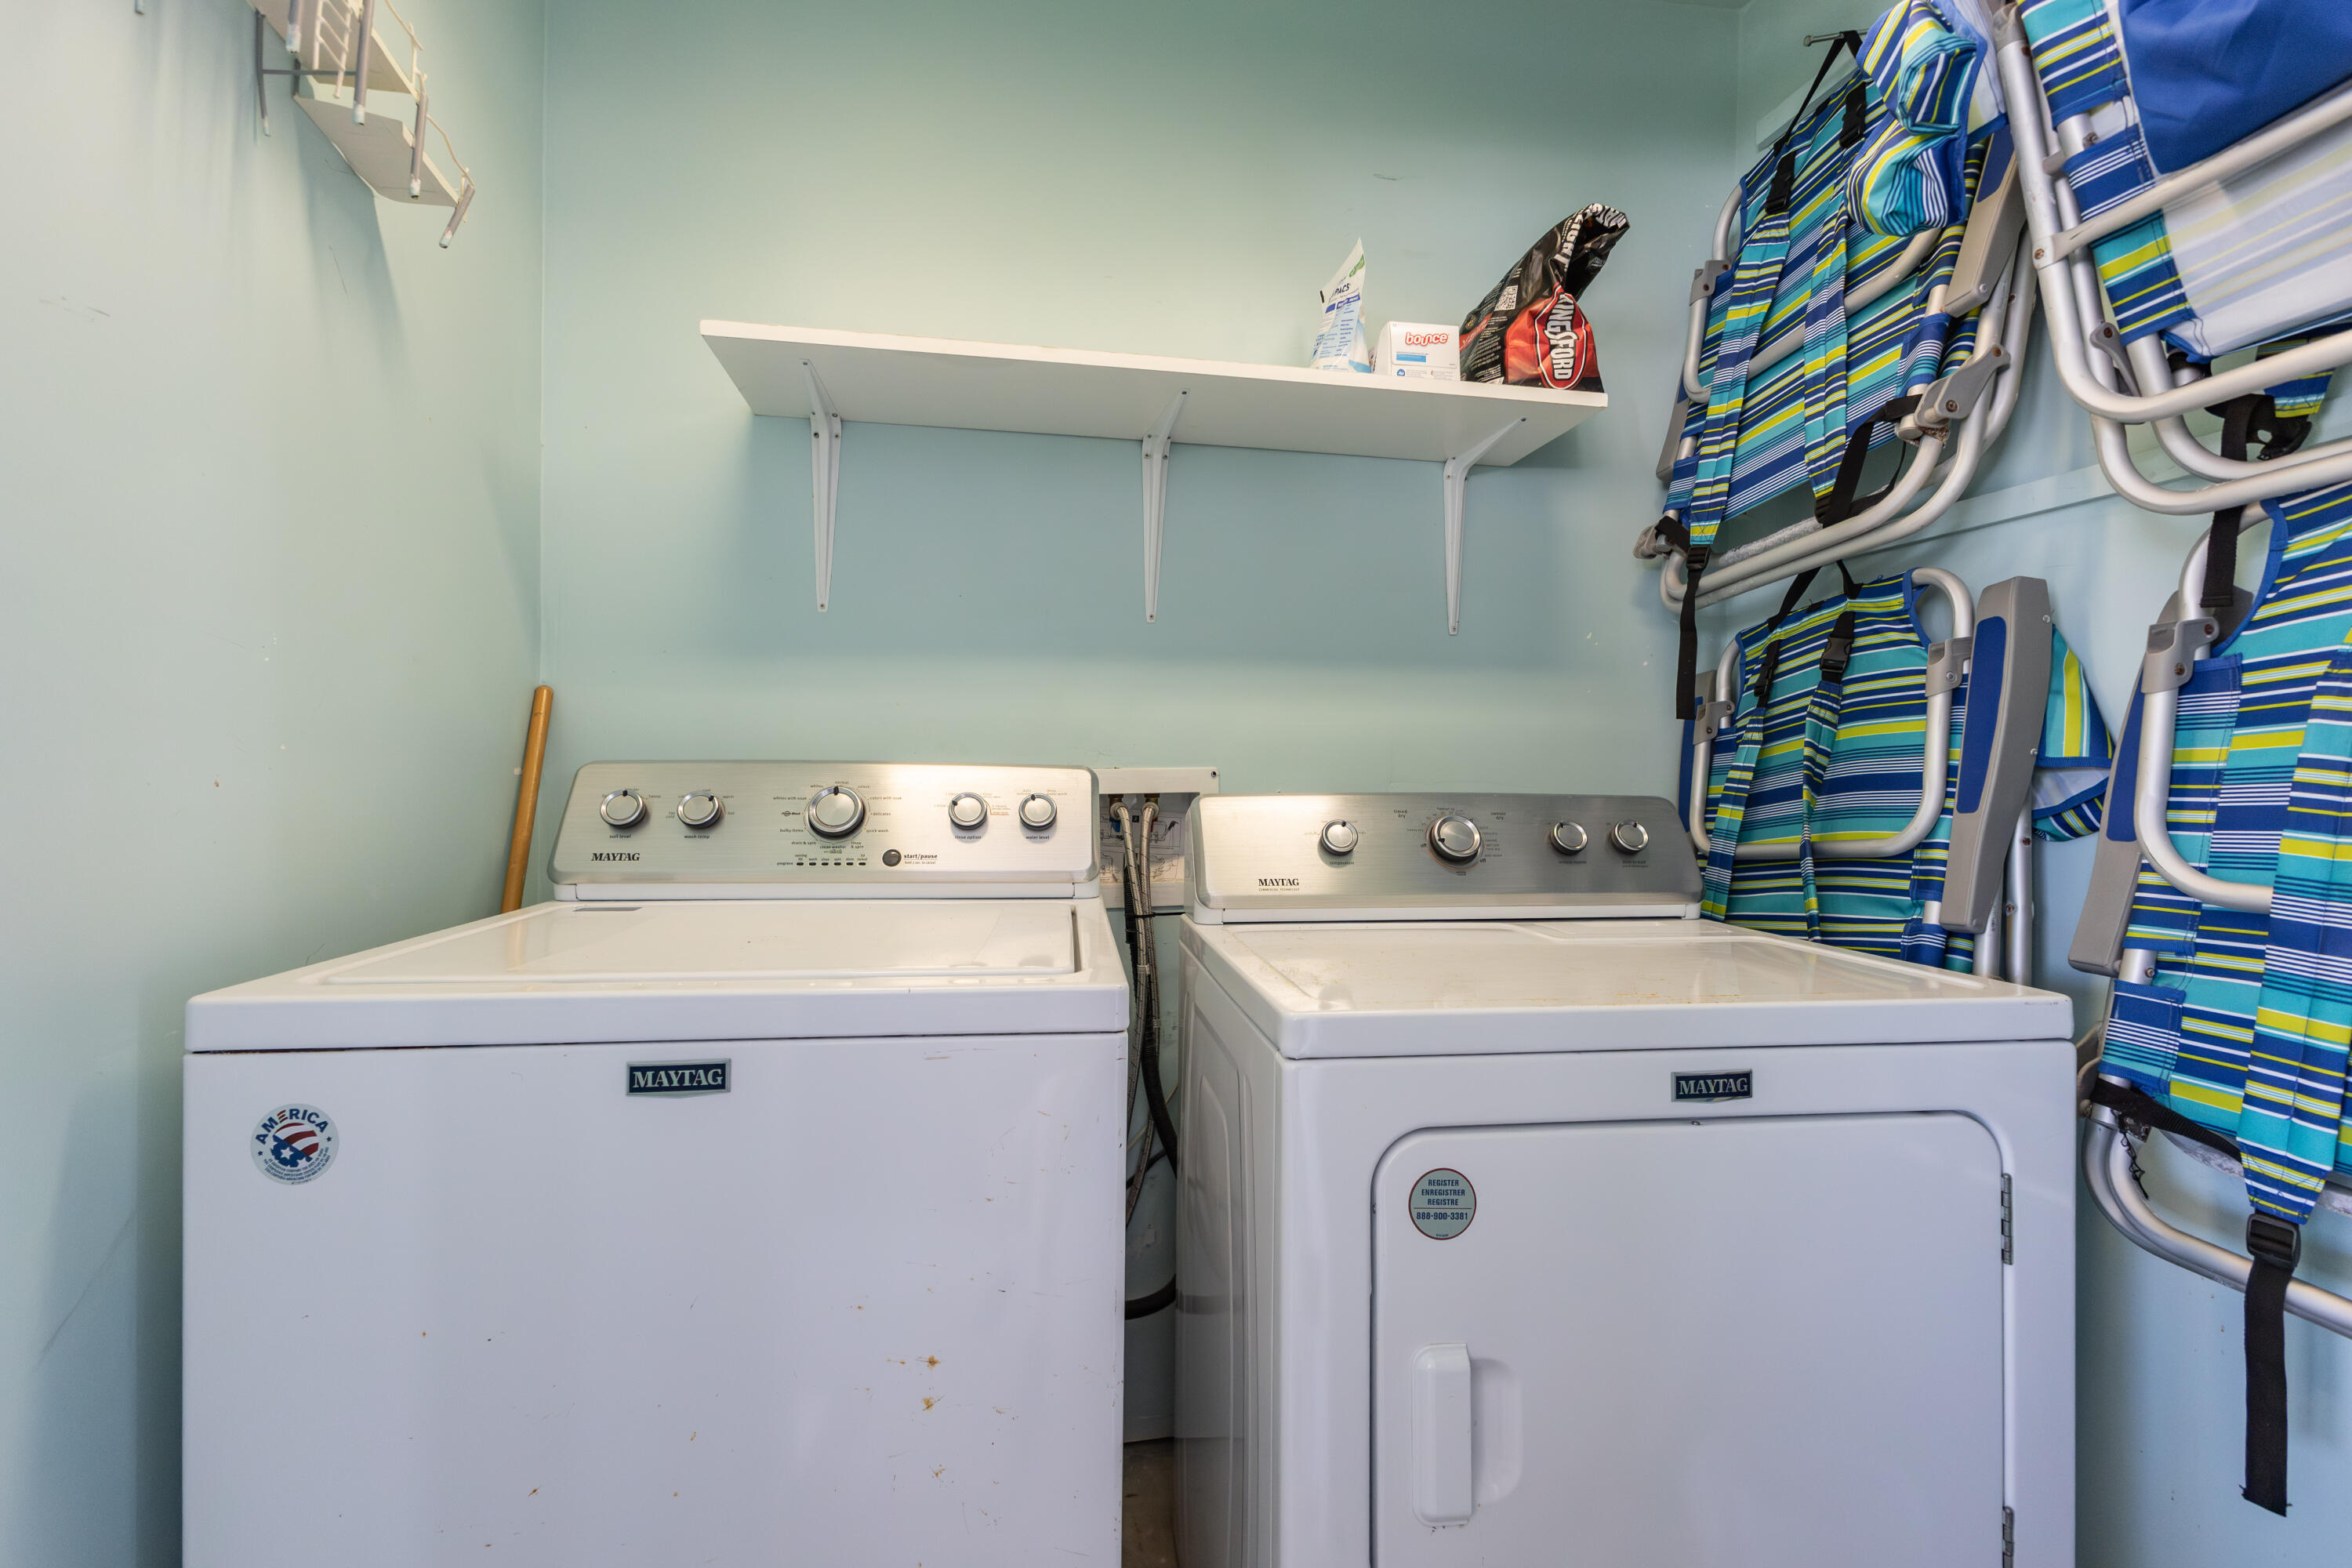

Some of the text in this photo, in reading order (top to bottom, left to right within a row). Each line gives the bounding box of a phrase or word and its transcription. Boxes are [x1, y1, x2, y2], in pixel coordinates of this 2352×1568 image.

[1405, 332, 1449, 347] bounce
[1544, 292, 1579, 379] KINGSFORD
[590, 852, 641, 862] MAYTAG
[1258, 878, 1299, 887] MAYTAG
[632, 1069, 724, 1088] MAYTAG
[1679, 1077, 1749, 1094] MAYTAG
[255, 1108, 329, 1146] AMERICA
